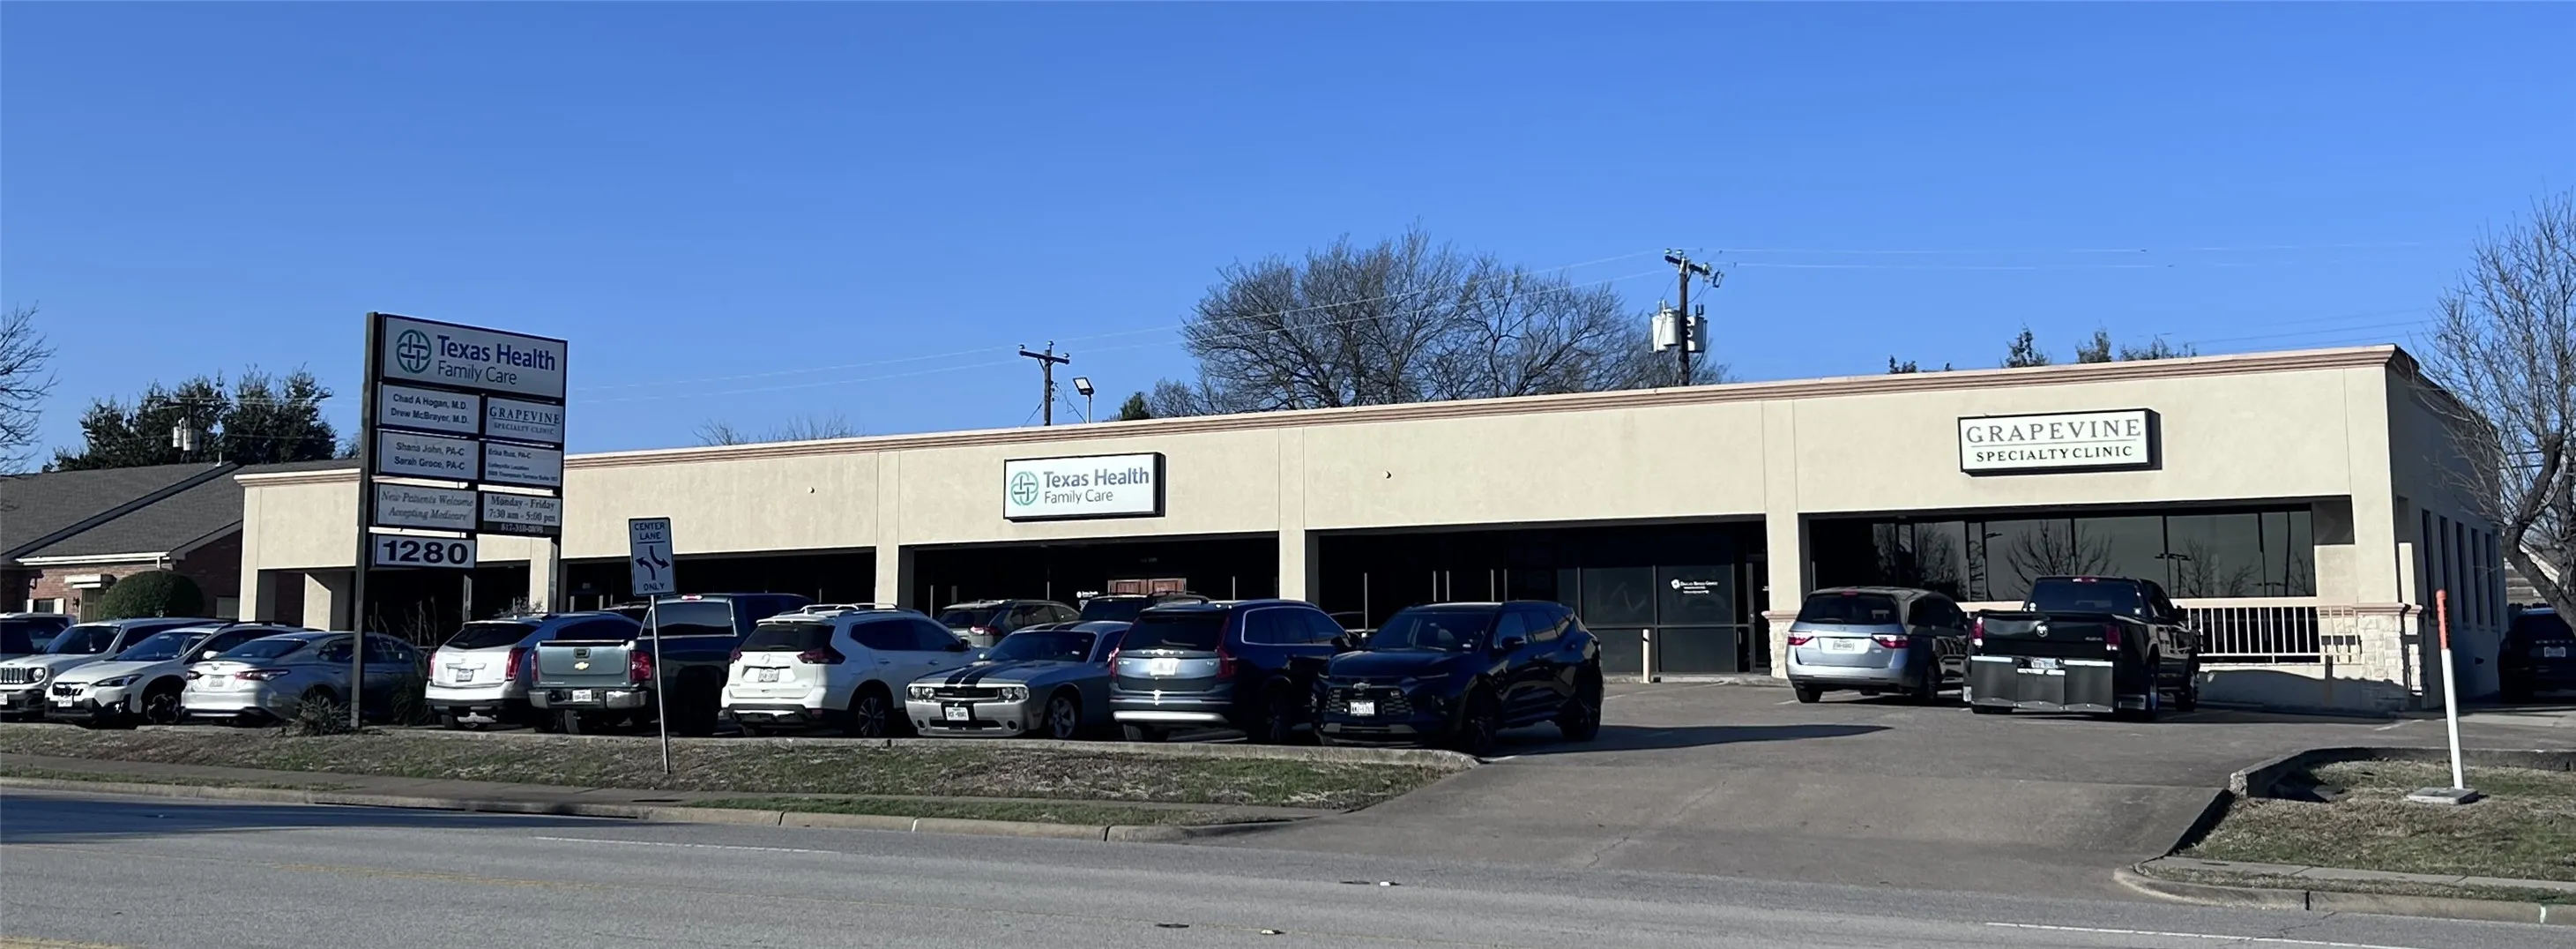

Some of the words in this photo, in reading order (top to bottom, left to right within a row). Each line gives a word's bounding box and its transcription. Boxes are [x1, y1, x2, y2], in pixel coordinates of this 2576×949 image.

[437, 335, 490, 362] Texas
[496, 343, 555, 370] Health
[437, 360, 482, 383] Family
[486, 366, 517, 385] Care
[392, 393, 413, 403] Chad
[415, 396, 421, 405] A
[422, 398, 450, 408] Hogan,
[451, 400, 468, 410] M.D.
[391, 407, 411, 417] Drew
[413, 410, 450, 422] McBrayer,
[452, 415, 469, 423] M.D.
[489, 406, 561, 424] GRAPEVINE
[494, 422, 529, 431] SPECIALTY
[1966, 419, 2141, 443] GRAPEVINE
[445, 446, 465, 456] PA-C
[1976, 448, 2068, 462] SPECIALTY
[2072, 445, 2133, 459] CLINIC
[394, 456, 417, 467] Sarah
[446, 460, 465, 470] PA-C
[1043, 470, 1089, 488] Texas
[1094, 467, 1150, 486] Health
[381, 490, 400, 502] New
[402, 492, 436, 504] Patients
[438, 495, 474, 506] Welcome
[491, 496, 523, 509] Monday
[530, 498, 555, 512] Friday
[1044, 490, 1083, 504] Family
[1085, 489, 1114, 503] Care
[389, 506, 428, 520] Accepting
[429, 508, 467, 521] Medicare
[489, 508, 506, 519] 7:30
[525, 511, 542, 521] 5:00
[543, 514, 556, 523] pm
[635, 522, 666, 531] CENTER
[639, 532, 662, 541] LANE
[383, 540, 469, 564] 1280
[643, 583, 666, 592] ONLY
